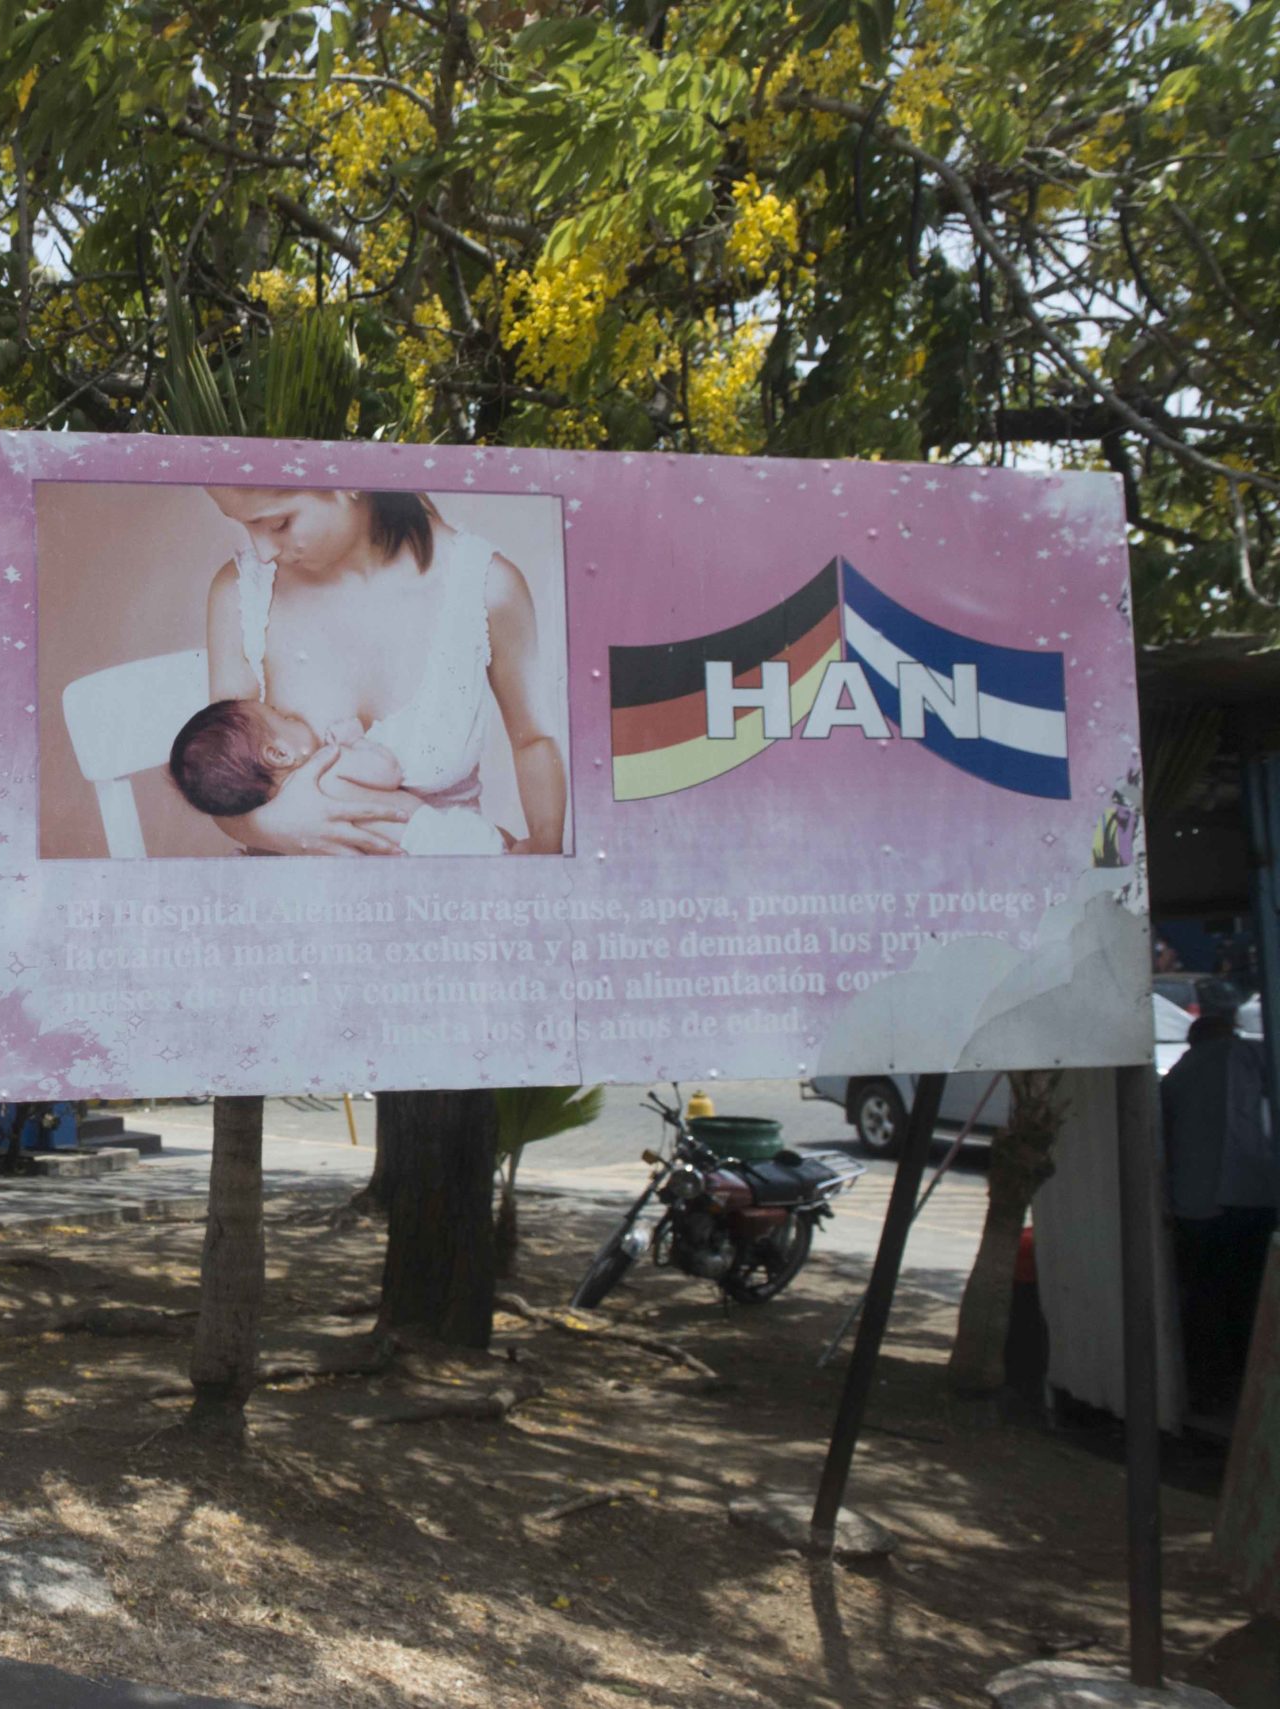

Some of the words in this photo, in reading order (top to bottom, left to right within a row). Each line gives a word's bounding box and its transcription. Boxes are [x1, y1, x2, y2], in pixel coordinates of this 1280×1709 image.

[705, 661, 981, 739] HAN
[64, 898, 101, 928] El
[111, 897, 257, 932] Hospital
[268, 894, 396, 924] Alemán
[405, 892, 631, 926] Nicaragüense,
[639, 896, 739, 925] apoya,
[747, 892, 897, 923] promueve
[904, 892, 921, 919] y
[927, 887, 1036, 919] protege
[64, 937, 221, 971] lactancia
[232, 938, 373, 967] materna
[385, 932, 535, 963] exclusiva
[543, 939, 563, 967] y
[572, 939, 589, 961] a
[598, 931, 671, 961] libre
[679, 928, 821, 958] demanda
[830, 926, 873, 954] los
[185, 981, 225, 1009] de
[238, 977, 320, 1008] edad
[334, 983, 352, 1011] y
[362, 973, 548, 1005] continuada
[559, 977, 616, 1001] con
[624, 965, 826, 1000] alimentación
[381, 1017, 472, 1046] hasta
[481, 1013, 527, 1042] los
[535, 1013, 591, 1042] dos
[599, 1012, 672, 1041] años
[681, 1009, 719, 1038] de
[727, 1005, 809, 1034] edad.
